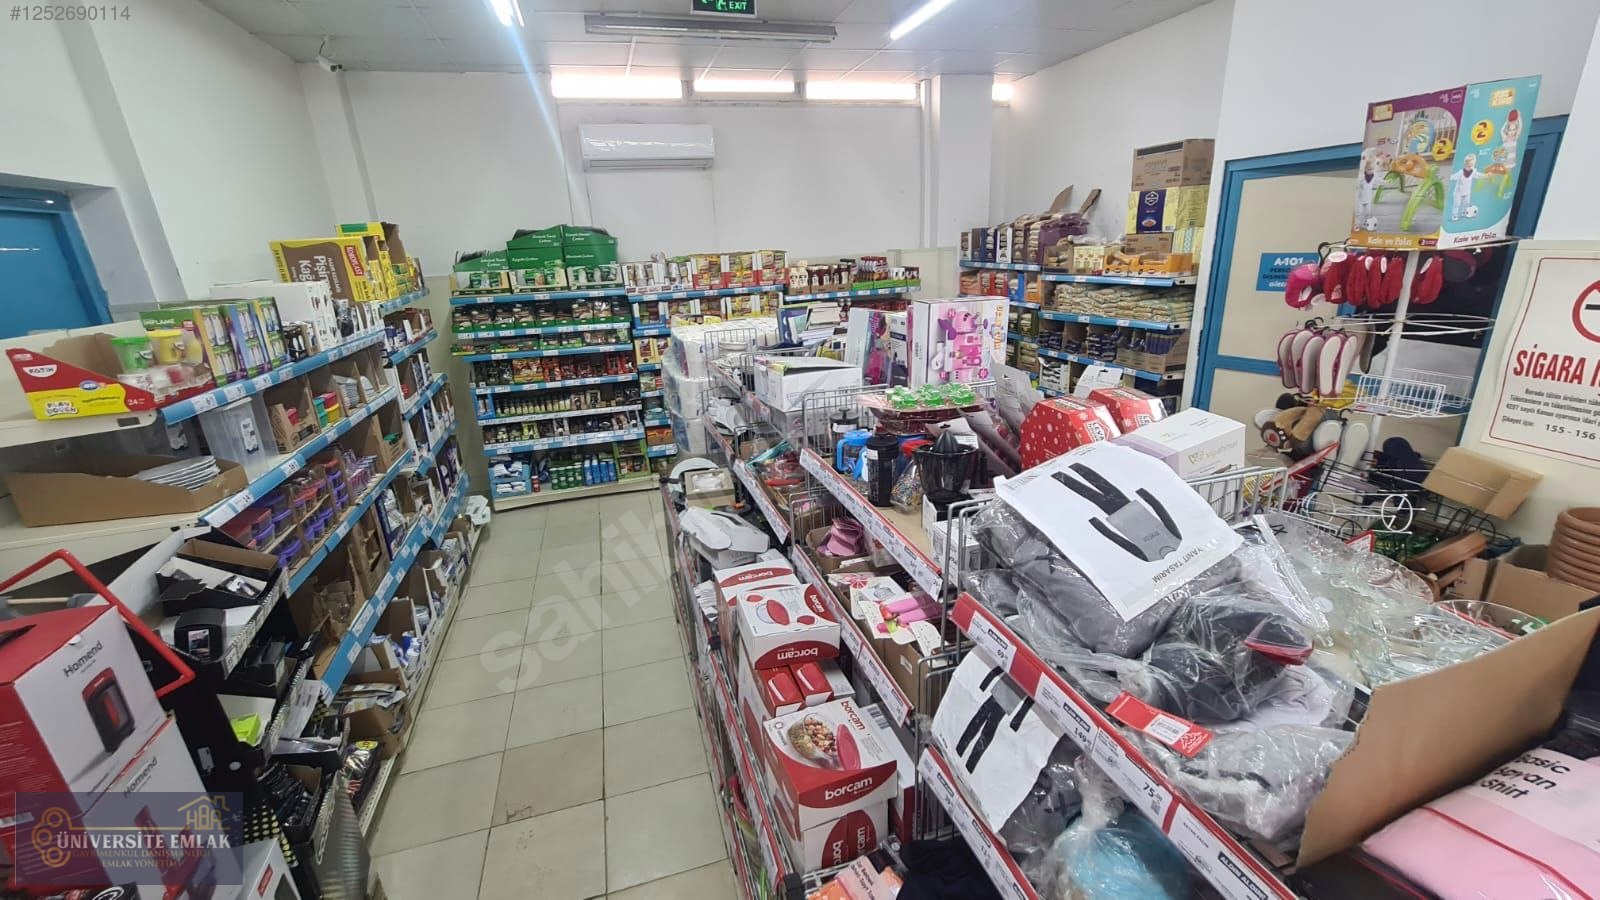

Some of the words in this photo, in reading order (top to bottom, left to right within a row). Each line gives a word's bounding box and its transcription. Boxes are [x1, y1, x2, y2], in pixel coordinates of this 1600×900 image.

[729, 1, 748, 11] EXIT
[1512, 343, 1586, 386] SİGARA
[1545, 423, 1566, 434] 155
[1575, 429, 1597, 440] 156
[1151, 560, 1183, 584] TASARIM
[63, 639, 104, 678] Homend
[777, 647, 819, 660] borcam
[840, 701, 866, 731] borcam
[123, 756, 158, 798] Homend
[824, 776, 873, 801] borcam
[1143, 782, 1156, 798] 75
